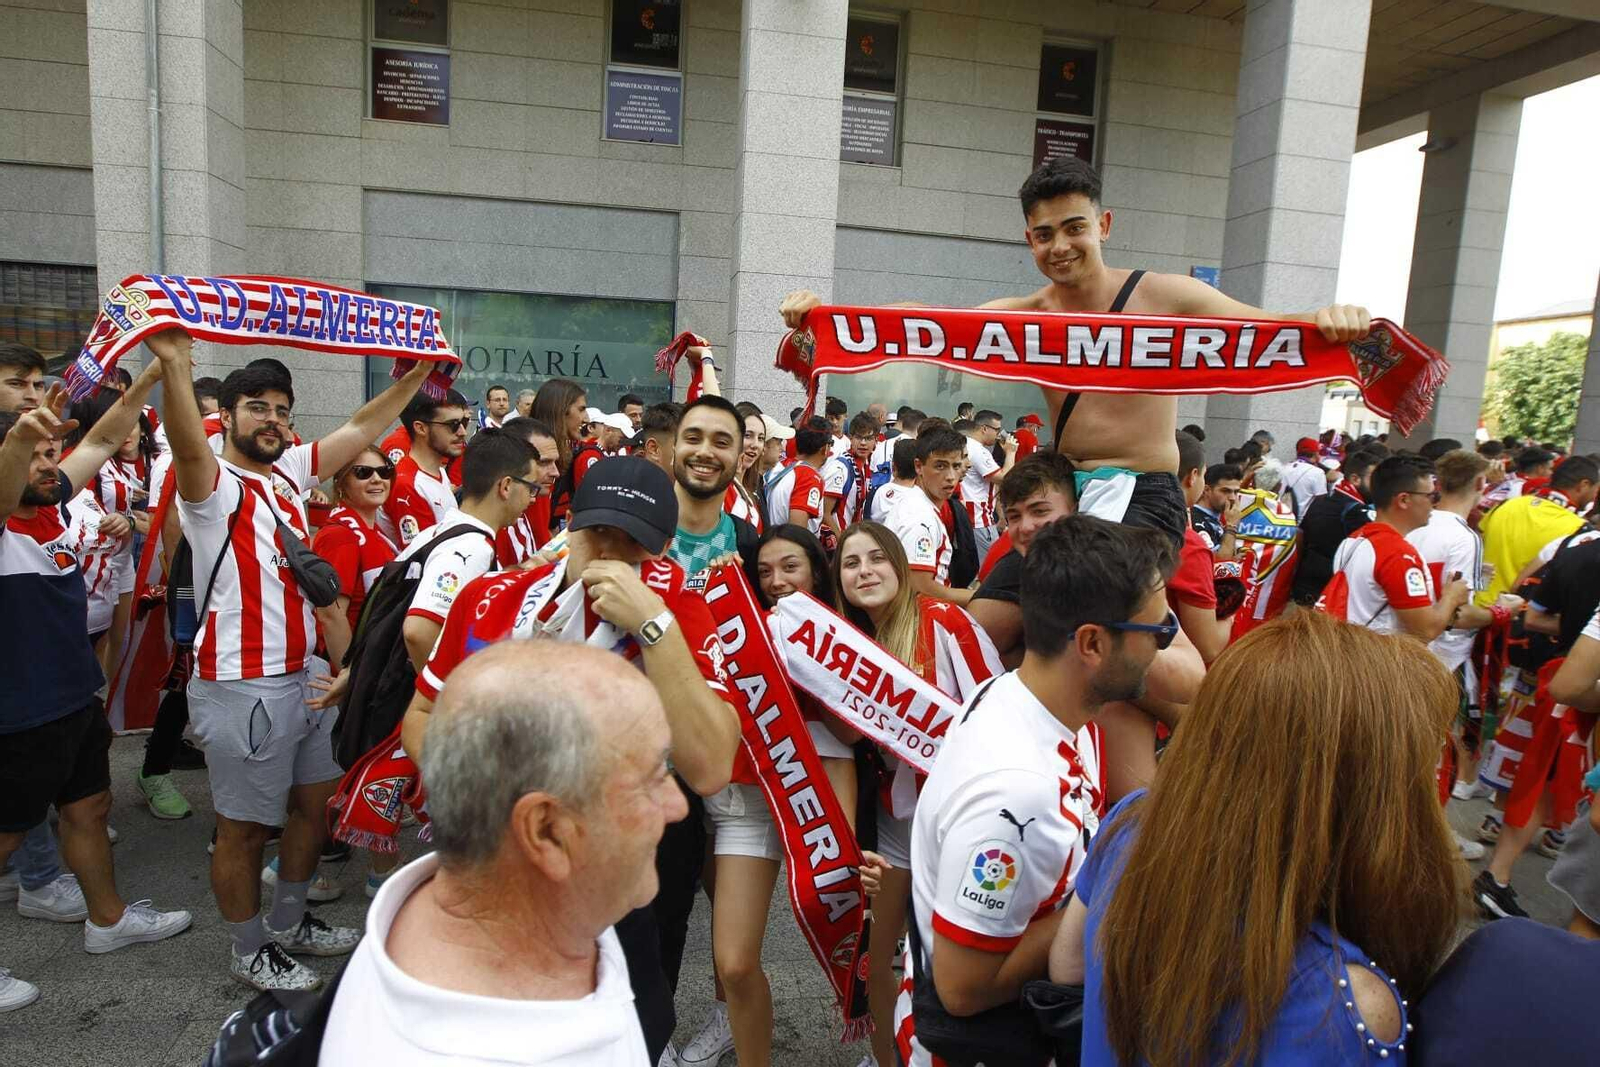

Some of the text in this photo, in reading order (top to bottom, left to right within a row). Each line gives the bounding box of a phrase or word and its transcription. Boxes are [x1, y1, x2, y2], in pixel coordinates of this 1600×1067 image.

[456, 344, 609, 379] OTARÍA
[1237, 520, 1292, 539] MERIA
[962, 886, 1005, 911] LaLiga
